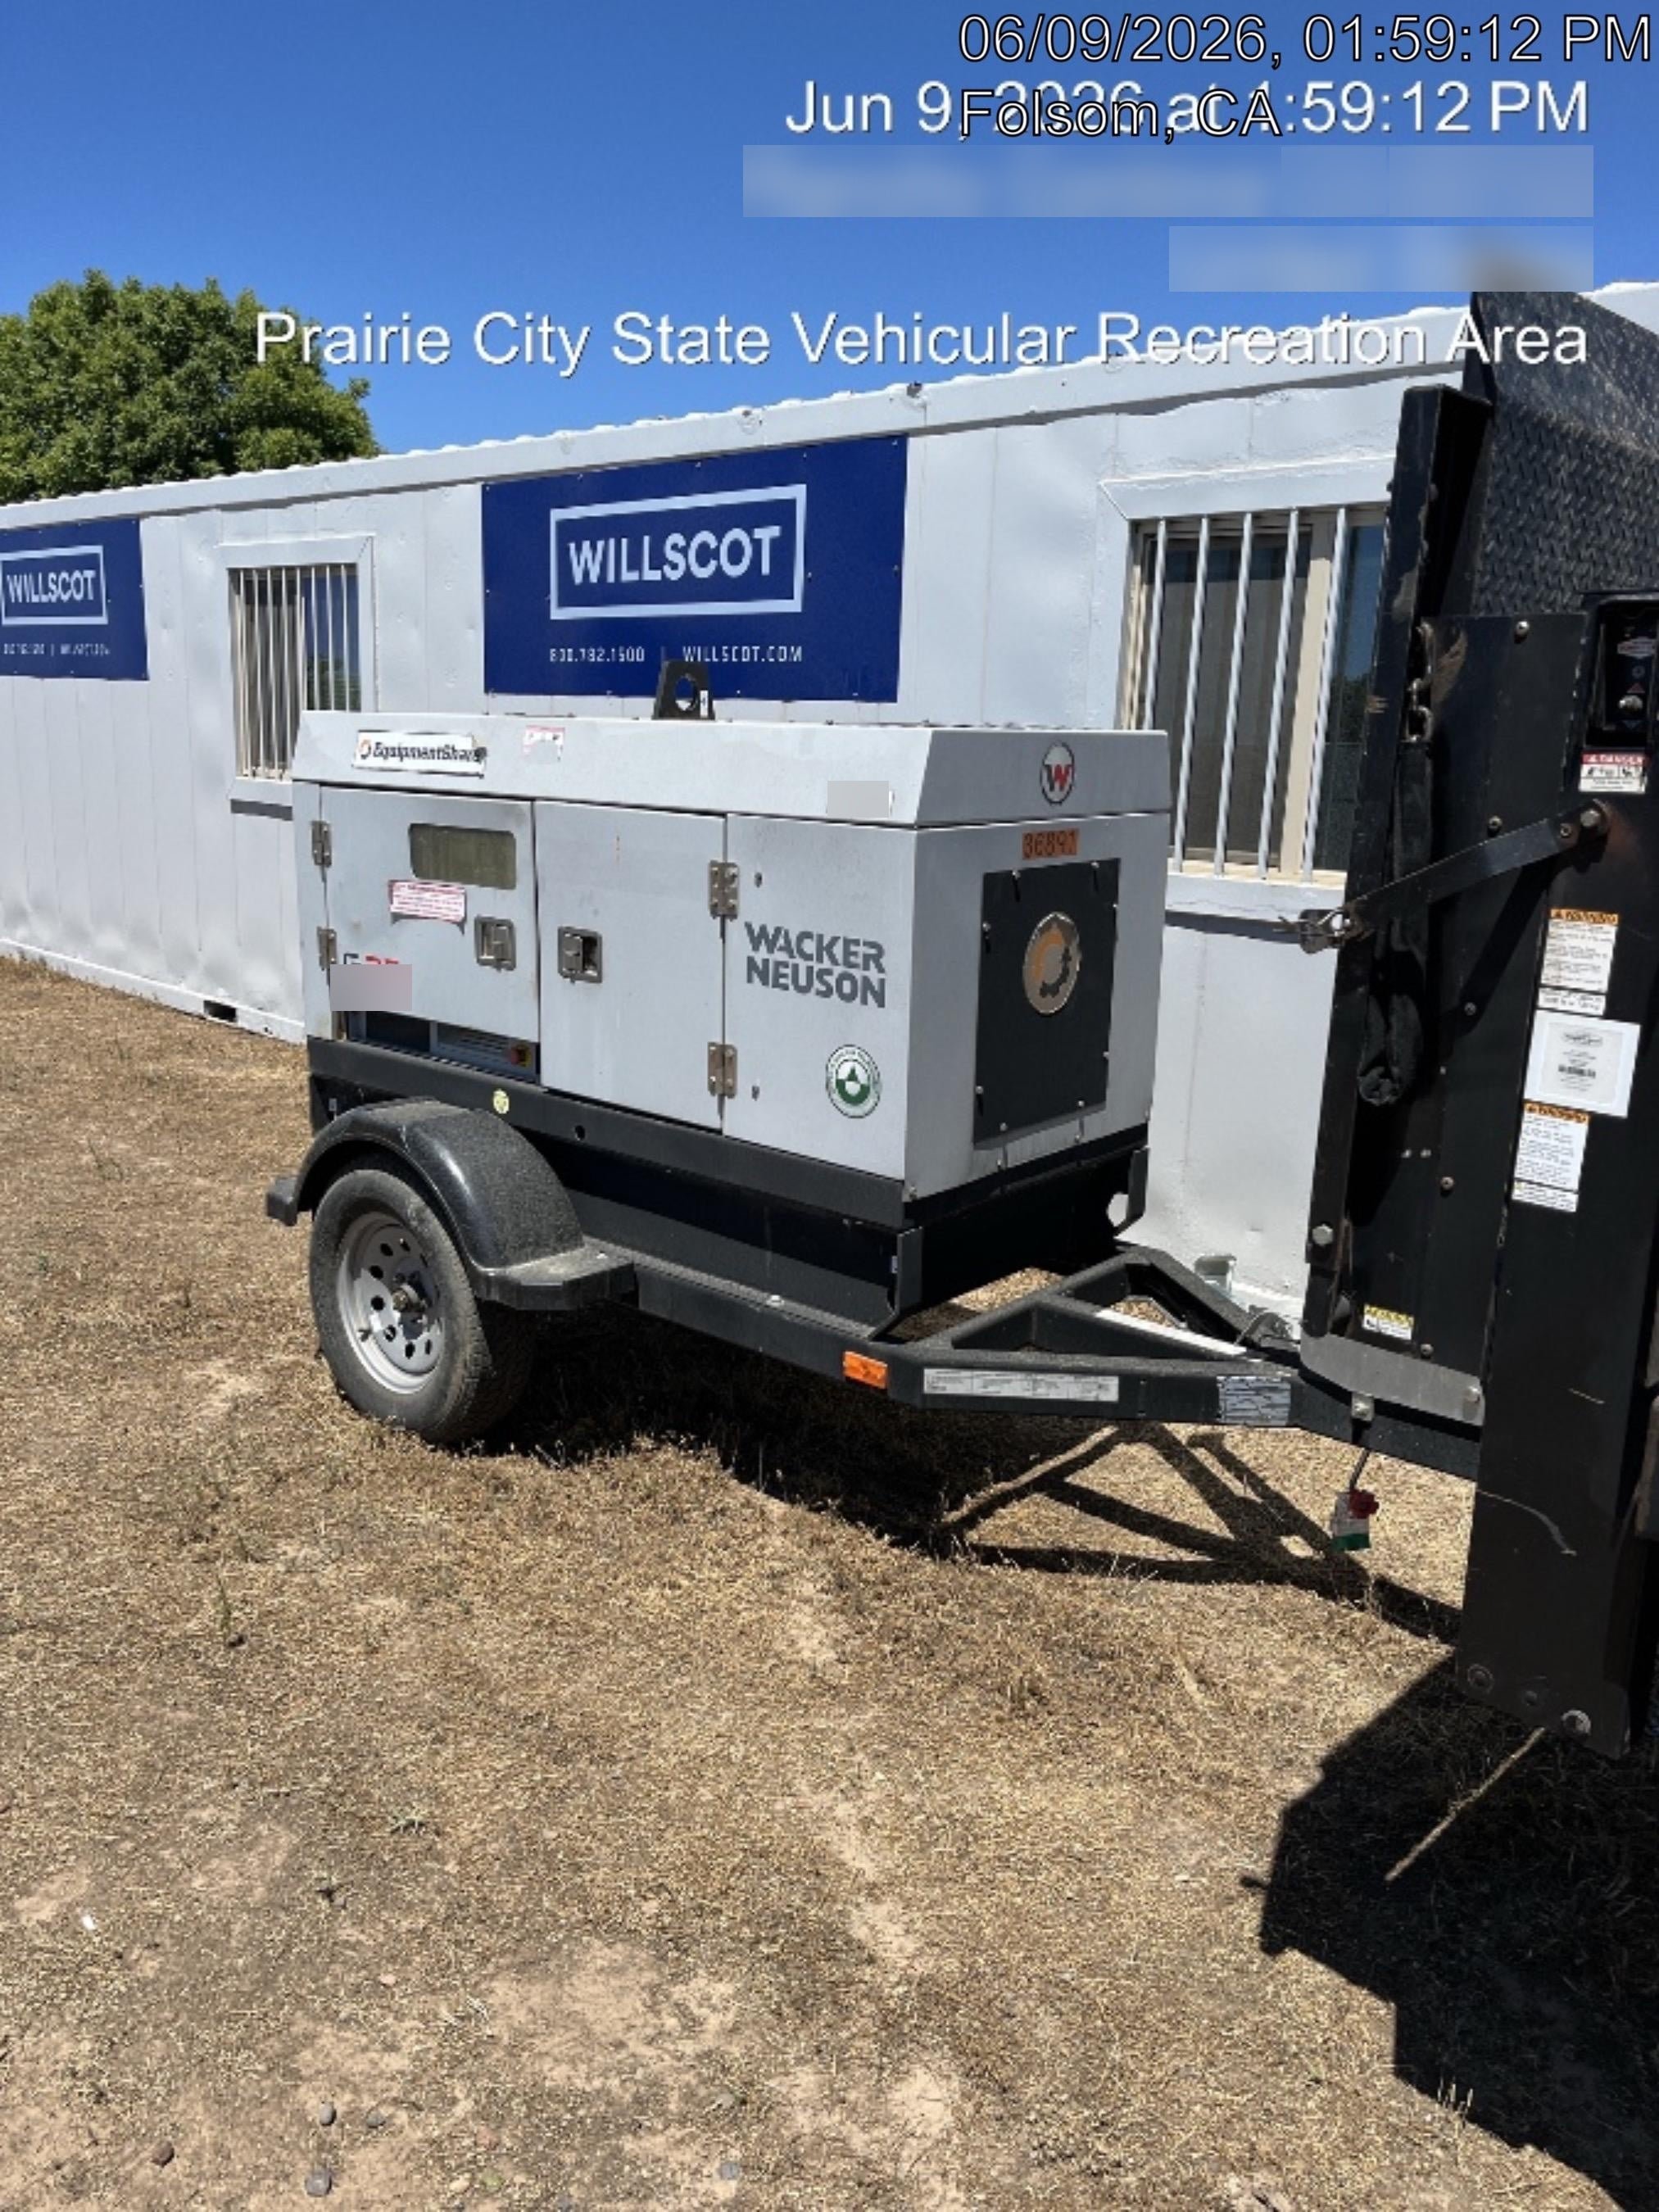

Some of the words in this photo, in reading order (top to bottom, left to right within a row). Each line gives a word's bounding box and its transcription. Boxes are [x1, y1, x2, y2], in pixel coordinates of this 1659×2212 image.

[568, 524, 782, 586] WILLSCOT
[6, 569, 97, 604] WILLSCOT
[682, 645, 804, 663] WILLSCOT.COM
[745, 921, 886, 973] WACKER
[746, 955, 886, 1009] NEUSON
